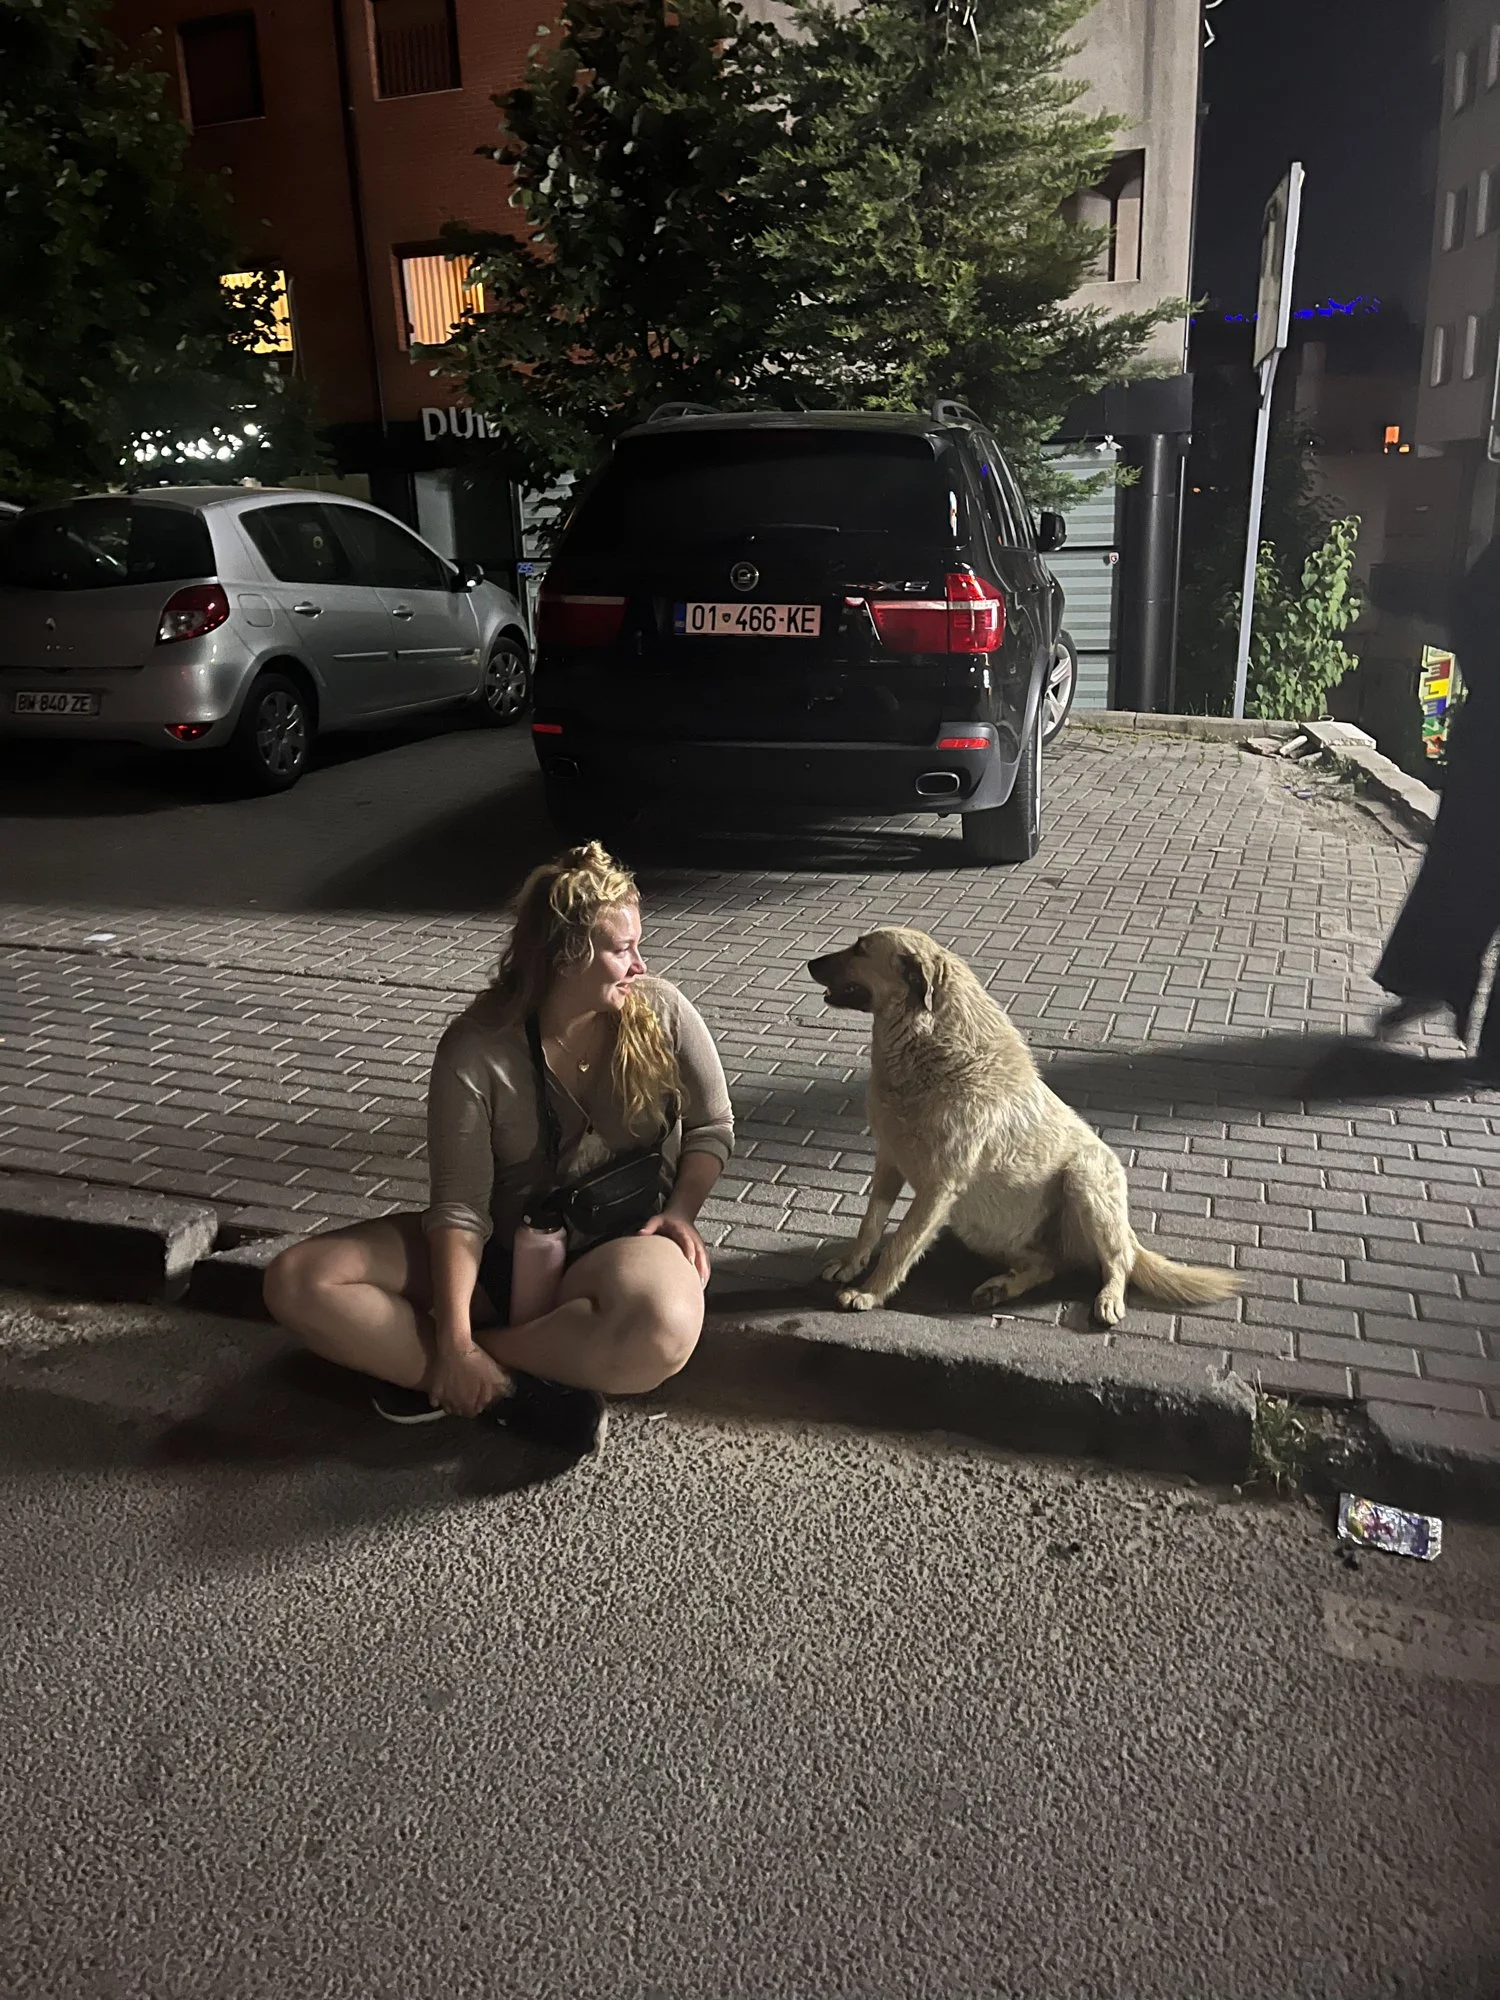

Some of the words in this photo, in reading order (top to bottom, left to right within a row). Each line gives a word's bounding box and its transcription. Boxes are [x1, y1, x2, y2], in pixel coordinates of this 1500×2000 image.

[692, 604, 717, 631] 01
[40, 694, 68, 711] 840
[71, 695, 90, 712] ZE
